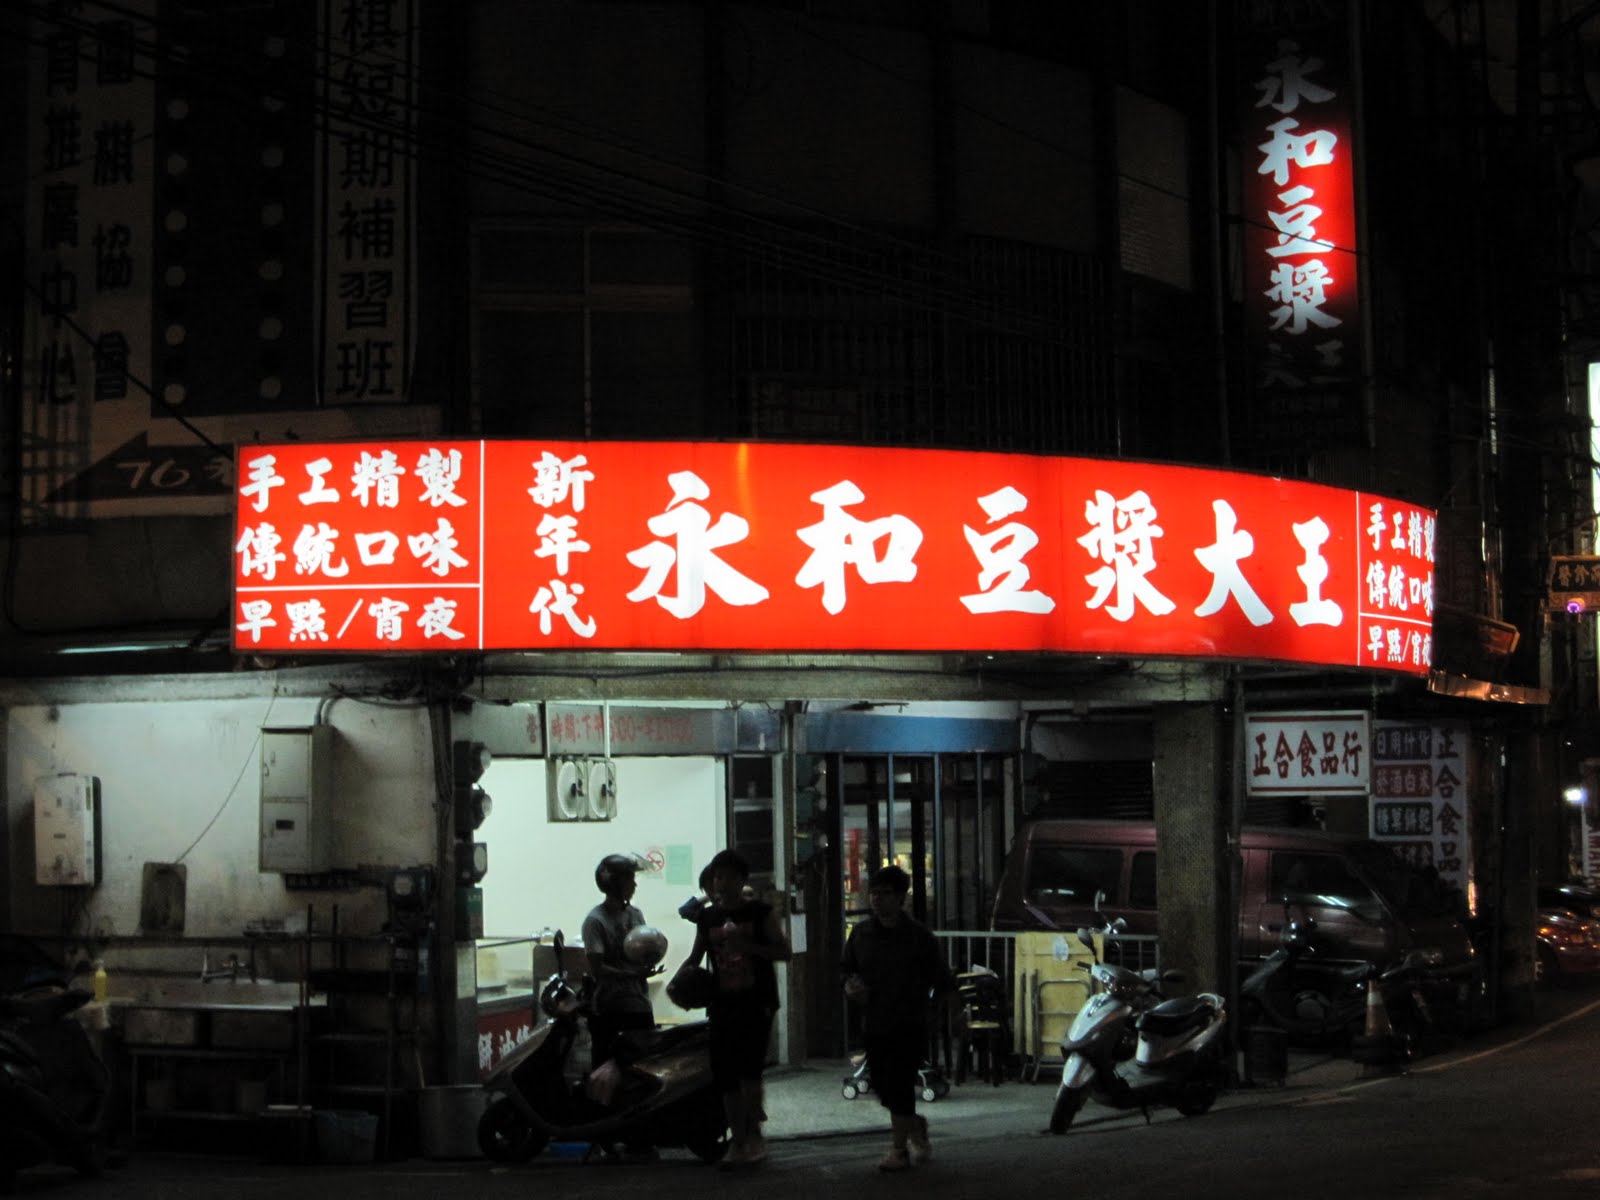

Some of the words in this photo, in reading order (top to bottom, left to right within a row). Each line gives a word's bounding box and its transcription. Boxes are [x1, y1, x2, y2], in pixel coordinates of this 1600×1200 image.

[1253, 38, 1343, 335] 永和豆漿
[240, 448, 468, 512] 手工精製
[236, 518, 469, 580] 傳統口味
[527, 451, 597, 638] 新年代
[626, 470, 1343, 627] 永和豆漿大王
[1366, 502, 1435, 562] 手工精製
[236, 597, 465, 642] 早點/宵夜
[1366, 560, 1434, 616] 傳統口味
[1252, 730, 1362, 779] 正合食品行
[1434, 728, 1462, 888] 正合食品
